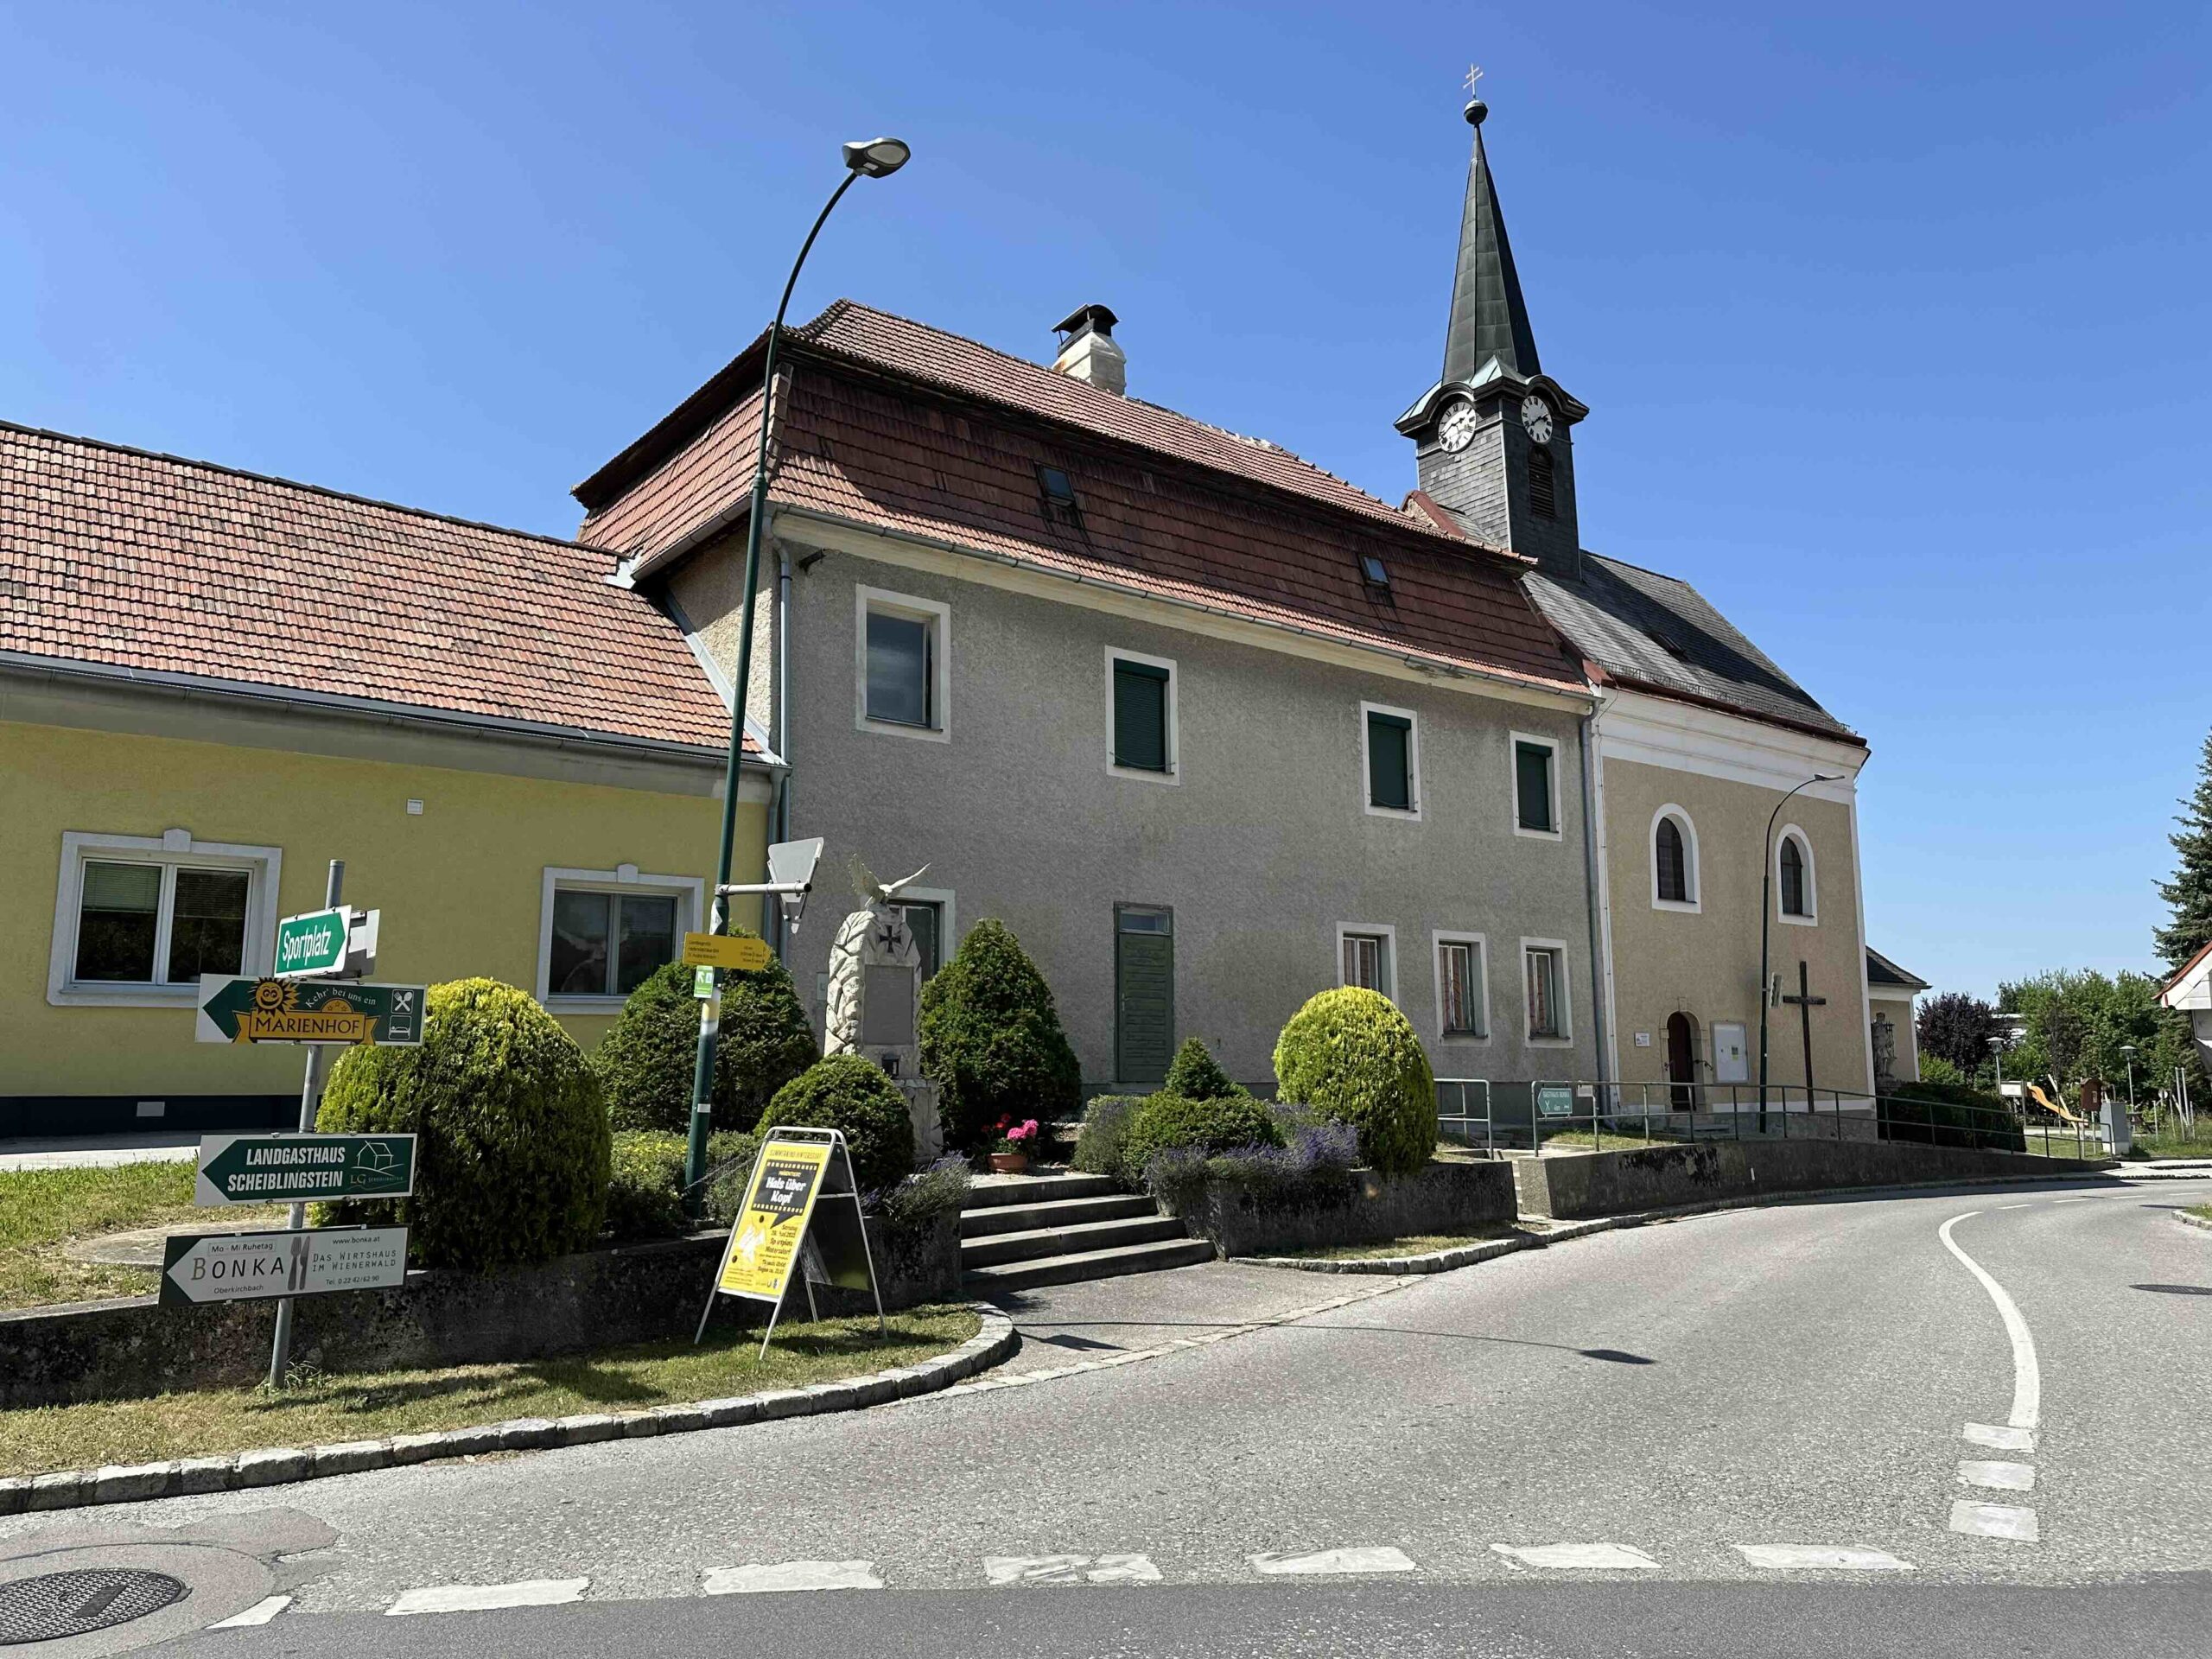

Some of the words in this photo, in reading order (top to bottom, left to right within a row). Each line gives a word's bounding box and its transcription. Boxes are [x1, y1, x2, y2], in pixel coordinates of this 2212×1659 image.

[283, 924, 331, 968] Sportplatz
[332, 988, 346, 997] bei
[347, 993, 362, 1002] uns
[364, 997, 376, 1006] ein
[255, 1018, 359, 1034] MARIENHOF
[245, 1147, 346, 1166] LANDGASTHAUS
[227, 1171, 343, 1192] SCHEIBLINGSTEIN
[350, 1174, 366, 1185] LG
[766, 1177, 785, 1189] Hals
[785, 1179, 807, 1192] über
[772, 1190, 793, 1205] Kopf
[332, 1236, 381, 1244] www.bonka.at
[313, 1253, 333, 1262] DAS
[340, 1249, 397, 1261] WIRTSHAUS
[191, 1256, 284, 1281] BONKA
[313, 1263, 325, 1272] IM
[332, 1259, 396, 1271] WIENERWALD
[213, 1284, 264, 1294] Oberkirchbach
